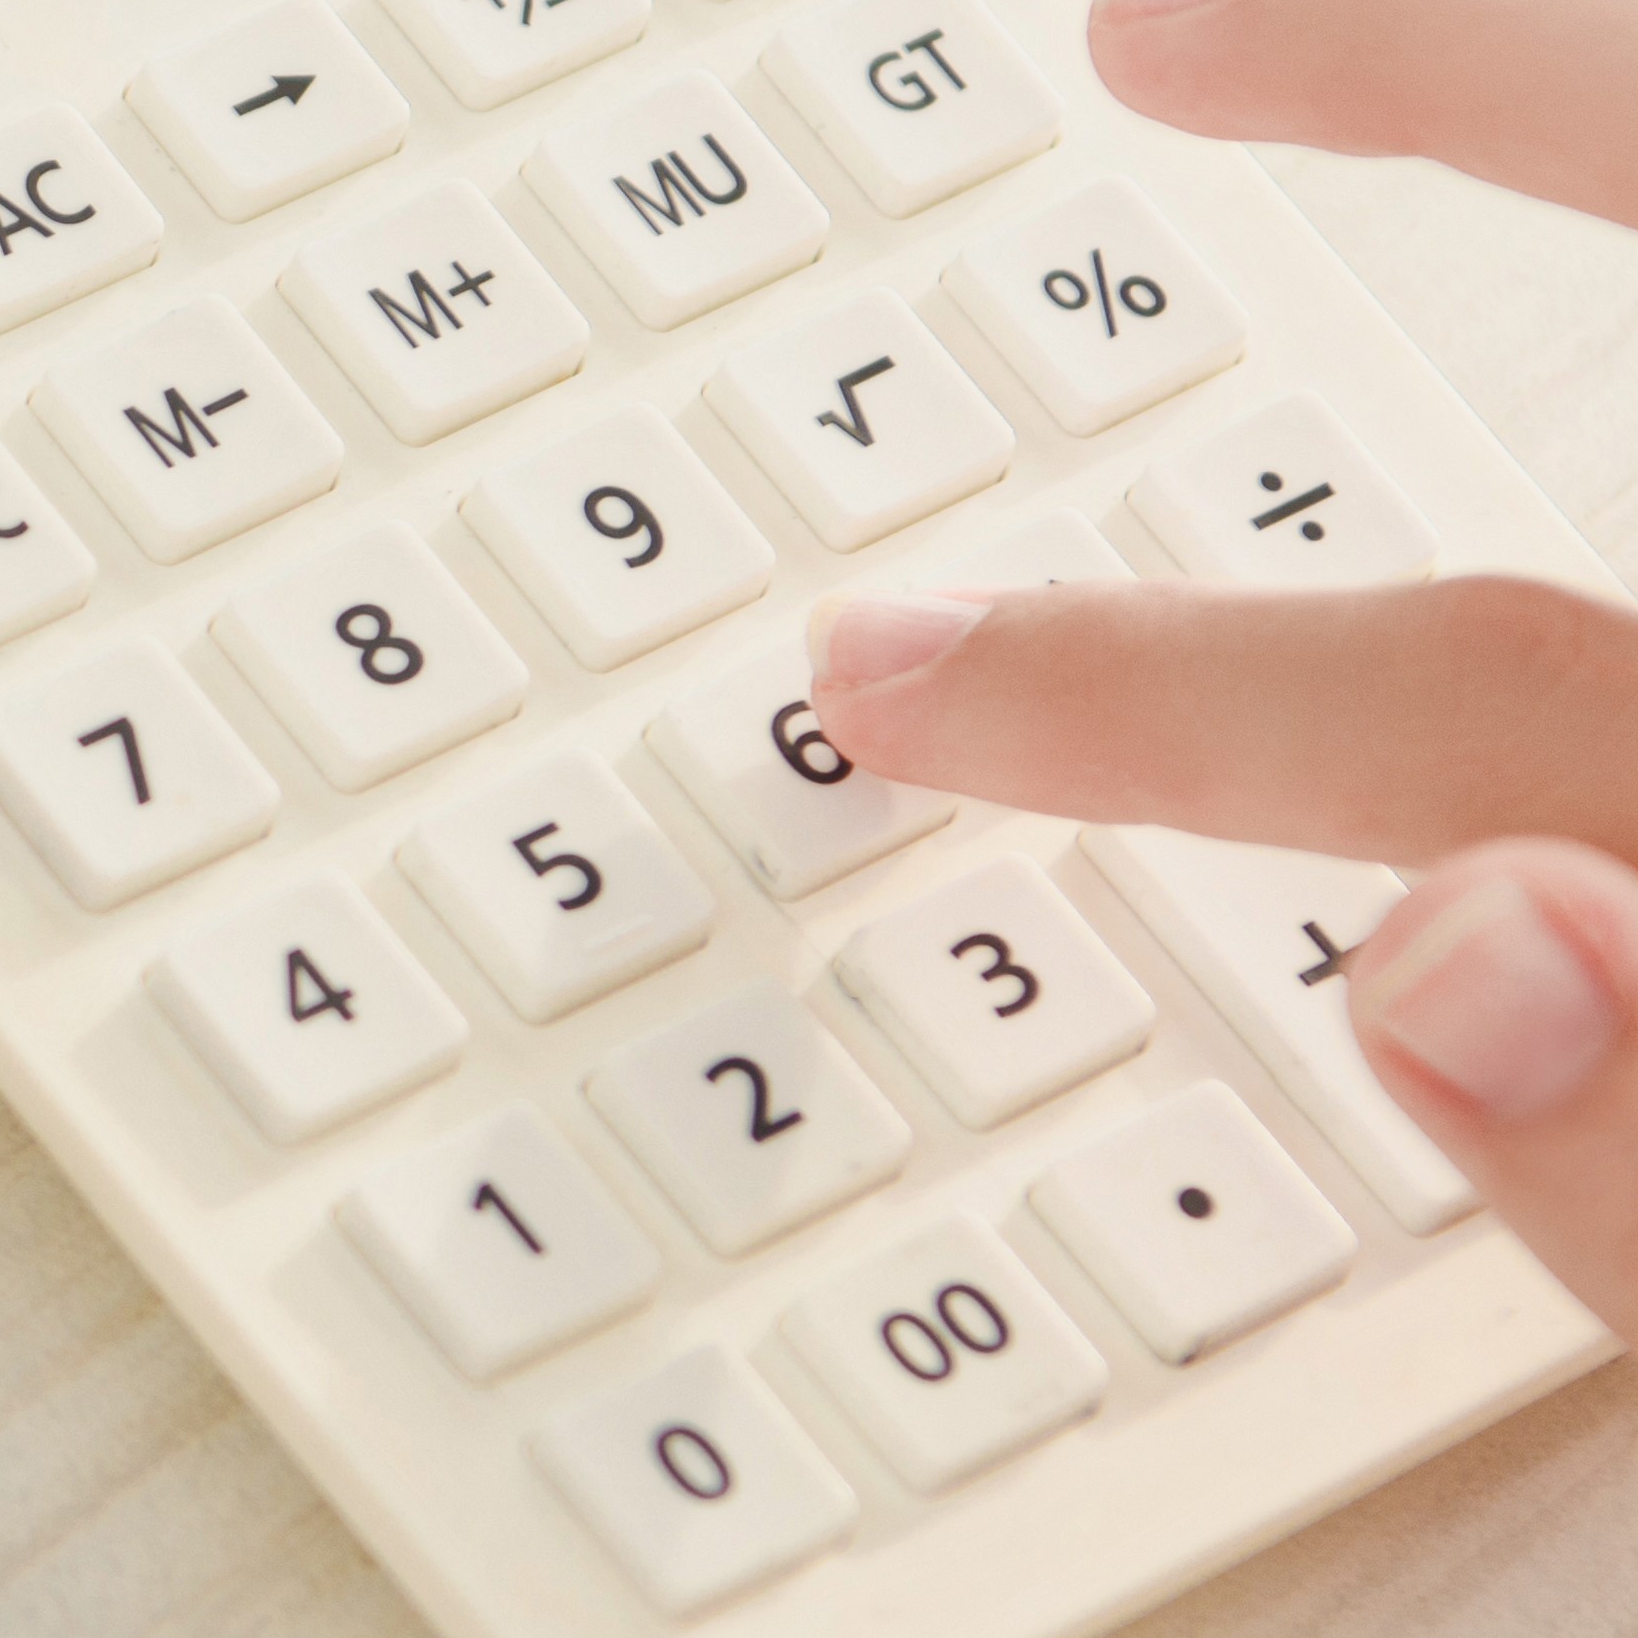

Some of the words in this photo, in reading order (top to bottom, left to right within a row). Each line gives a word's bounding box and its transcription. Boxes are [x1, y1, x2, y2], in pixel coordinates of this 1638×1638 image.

[867, 28, 967, 112] GT
[612, 133, 748, 236] MU
[367, 261, 495, 349] M+
[1042, 248, 1167, 339] %
[582, 485, 665, 569] 9
[334, 603, 425, 686] 8
[76, 716, 152, 806] 7
[770, 700, 851, 786] 6
[511, 821, 604, 912] 5
[285, 948, 355, 1023] 4
[949, 932, 1040, 1019] 3
[704, 1055, 804, 1144] 2
[471, 1181, 544, 1255] 1
[879, 1282, 1011, 1383] 00
[652, 1423, 733, 1501] 0
